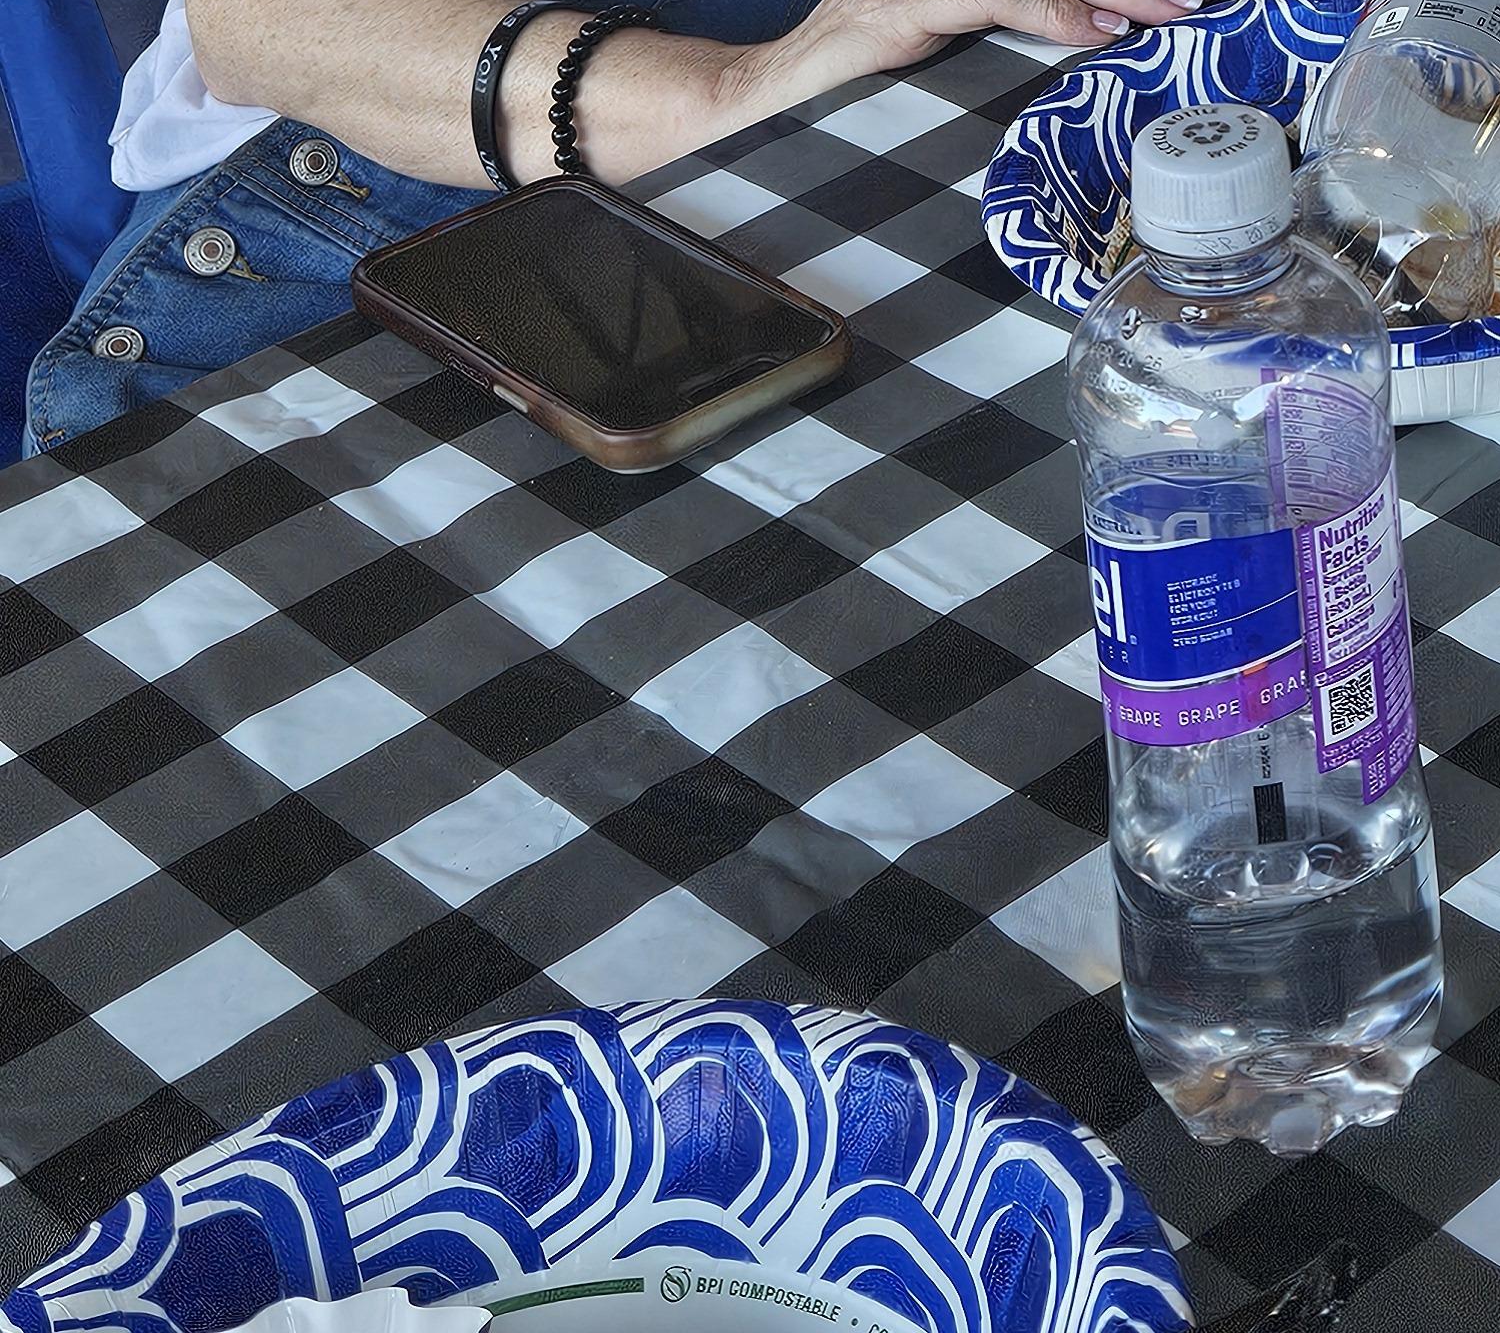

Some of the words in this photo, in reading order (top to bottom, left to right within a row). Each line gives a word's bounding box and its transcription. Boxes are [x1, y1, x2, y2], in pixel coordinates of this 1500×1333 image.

[1386, 11, 1397, 23] 0
[1319, 494, 1385, 552] Nutrition
[1321, 535, 1369, 574] Facts
[1091, 560, 1127, 643] el
[1178, 699, 1241, 727] GRAPE
[695, 1276, 724, 1295] BPI
[728, 1279, 842, 1323] COMPOSTABLE
